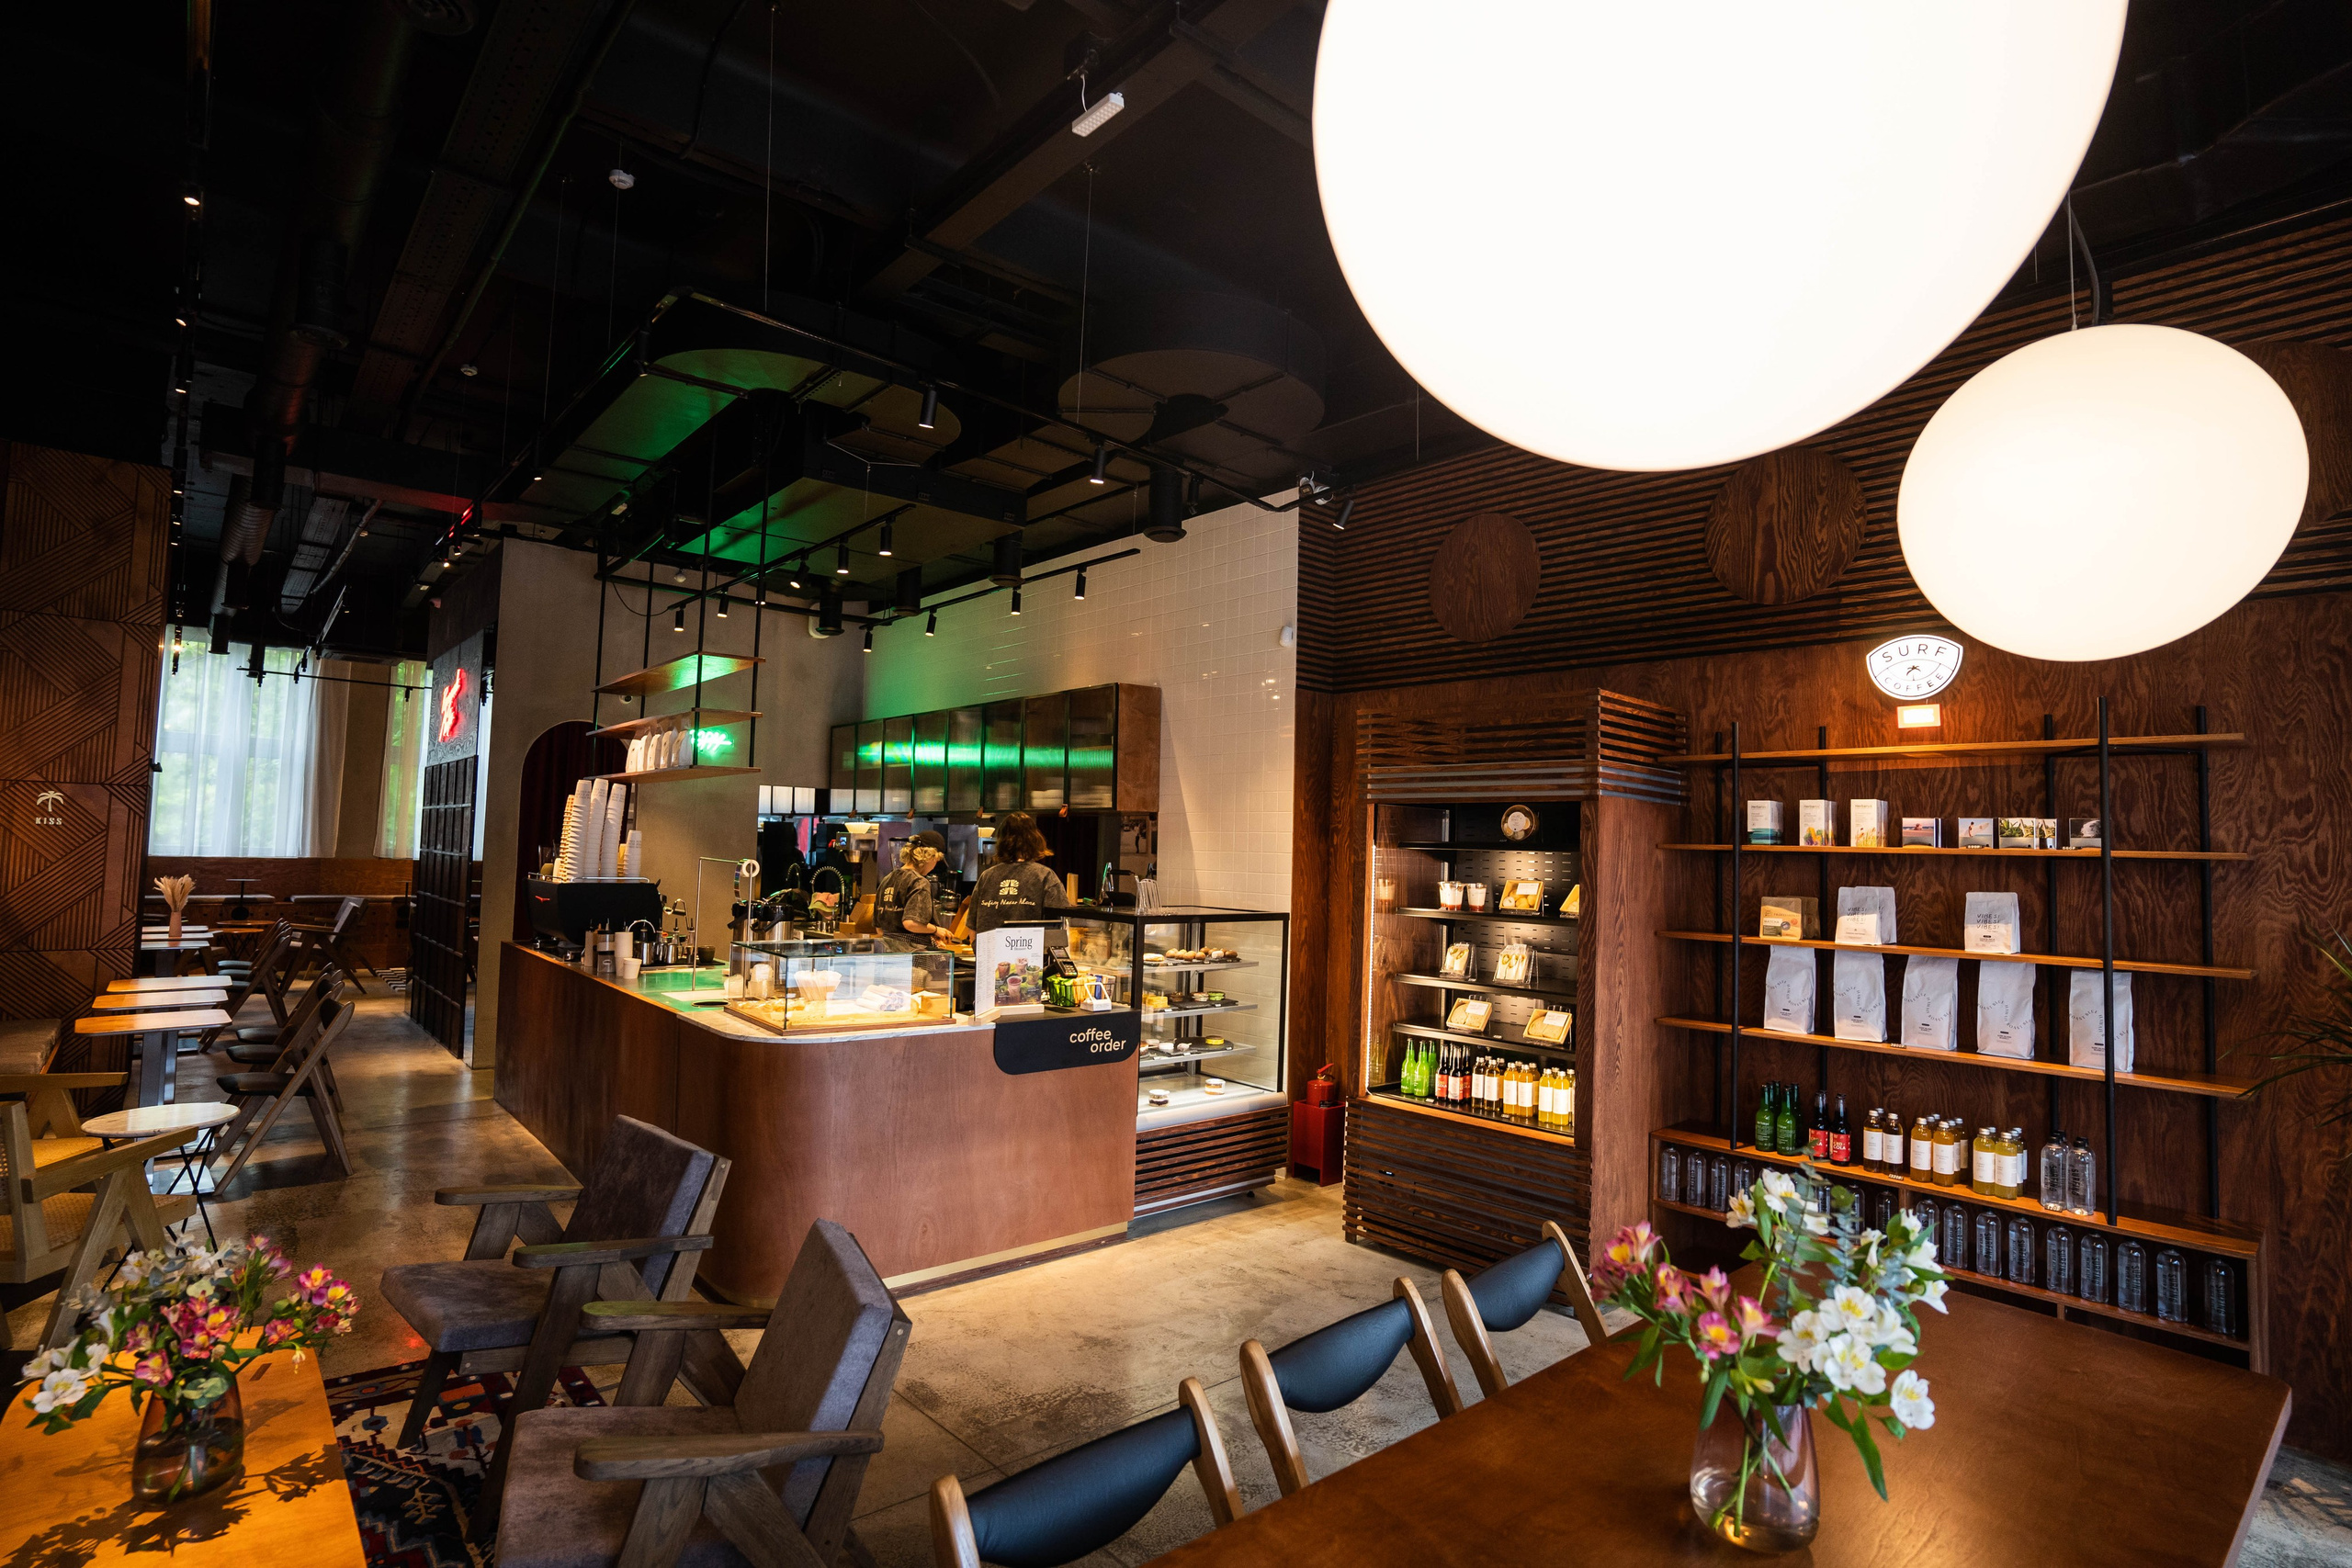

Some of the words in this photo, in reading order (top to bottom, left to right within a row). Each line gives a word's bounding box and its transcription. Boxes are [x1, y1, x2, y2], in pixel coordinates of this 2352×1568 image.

[1882, 643, 1947, 662] SURF
[1884, 672, 1944, 692] COFFEE
[35, 817, 62, 825] KISS
[1005, 935, 1033, 951] Spring
[1069, 1027, 1112, 1043] coffee
[1090, 1038, 1126, 1054] order
[2071, 1168, 2080, 1196] SURFING
[1984, 1233, 1994, 1259] SURFING
[2057, 1249, 2066, 1277] SURFING
[2091, 1256, 2101, 1286] SURFING
[2168, 1273, 2179, 1304] SURFING
